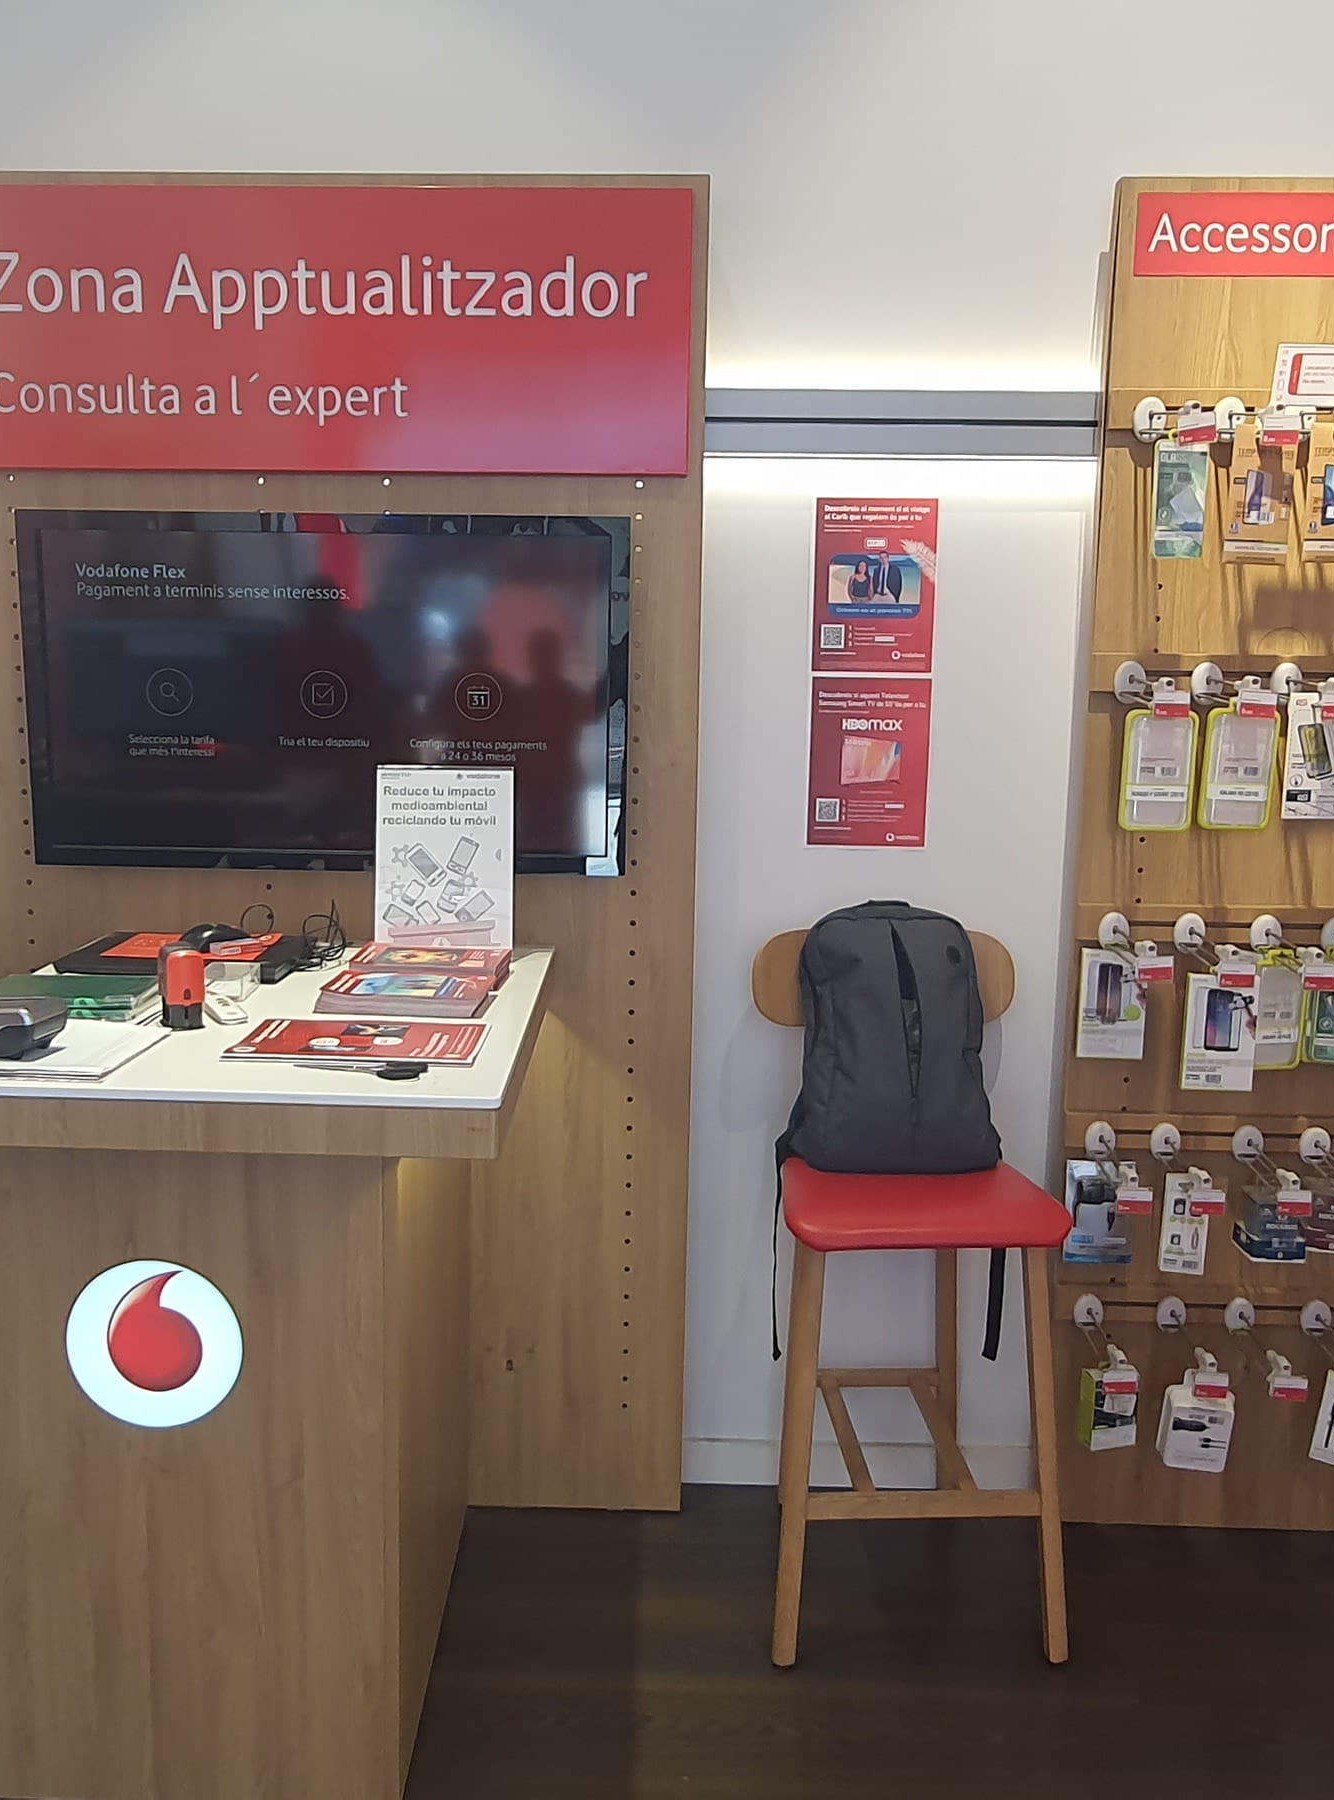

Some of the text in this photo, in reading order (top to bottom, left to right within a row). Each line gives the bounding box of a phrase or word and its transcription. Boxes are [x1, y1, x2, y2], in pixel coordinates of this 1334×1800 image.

[163, 252, 649, 331] Apptualitzador
[194, 383, 214, 416] a
[75, 562, 186, 580] Vodafone Flex
[76, 583, 351, 601] Pagament a terminis sense interessos.
[471, 695, 486, 706] 31
[129, 734, 215, 745] Selecciona la tarifa
[278, 736, 370, 748] Tria el teu dispositiu
[409, 738, 547, 752] Configura els teus pagaments
[129, 748, 146, 757] que
[149, 746, 168, 756] més
[448, 752, 461, 761] 24
[470, 752, 484, 761] 36
[486, 754, 516, 762] mesos
[383, 785, 496, 799] Reduce tu impacto
[391, 800, 488, 811] medioambiental
[383, 815, 497, 826] reciclando tu móvil
